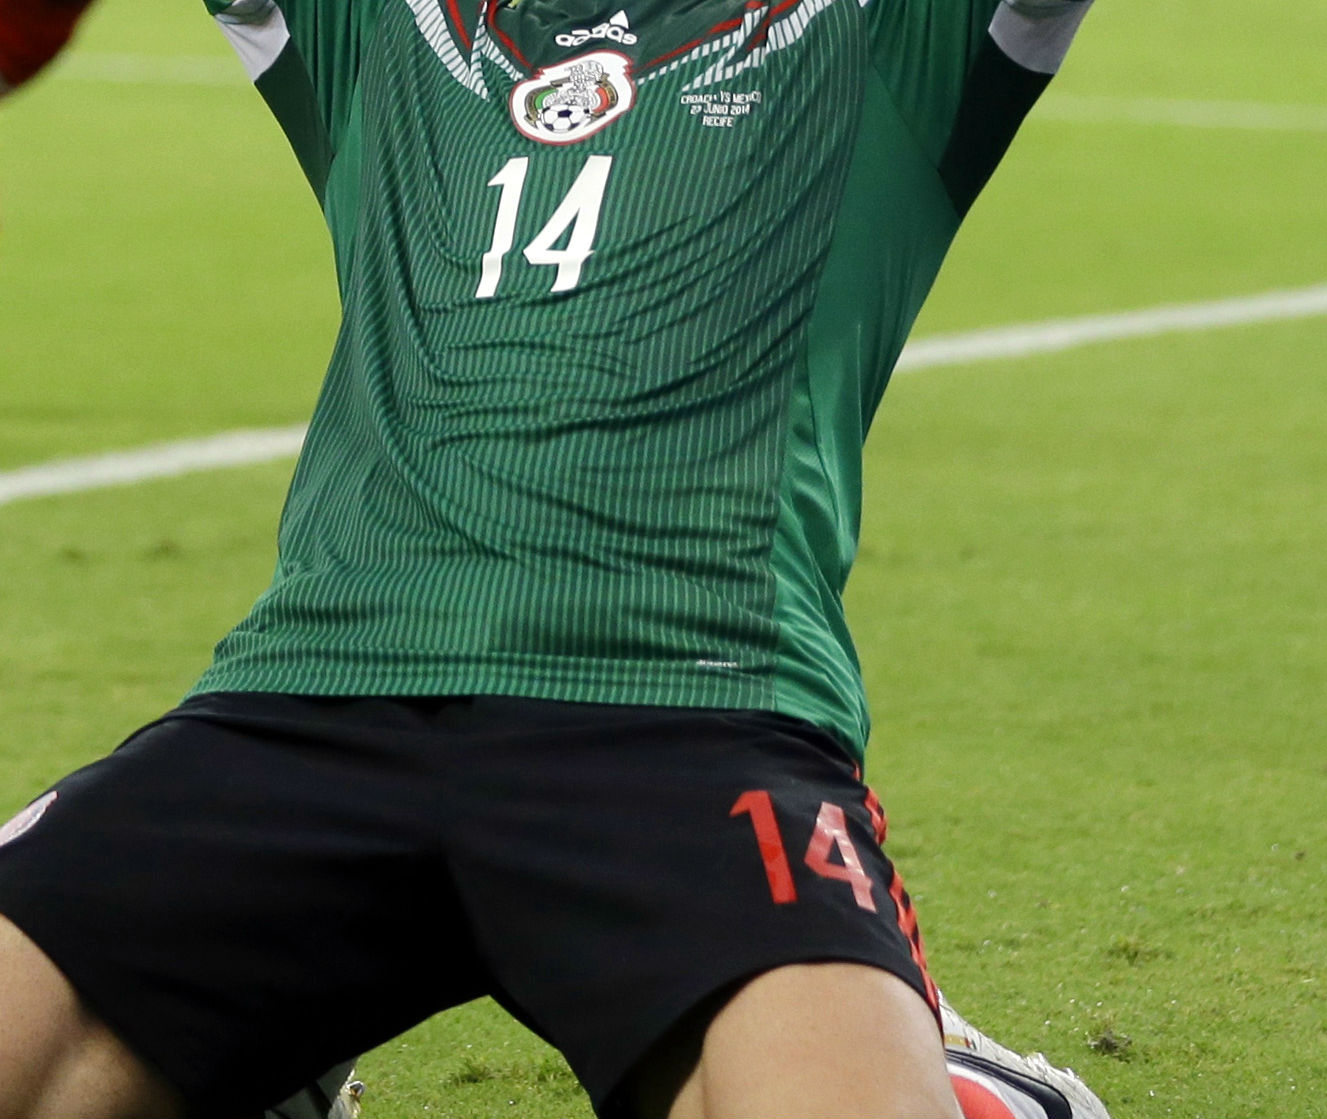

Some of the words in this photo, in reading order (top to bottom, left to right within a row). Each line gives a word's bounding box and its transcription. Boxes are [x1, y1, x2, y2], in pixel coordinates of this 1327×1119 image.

[702, 115, 734, 127] RECIFE
[703, 102, 728, 115] JUNIO
[730, 104, 750, 115] 2014
[474, 154, 614, 299] 14
[728, 788, 878, 914] 14
